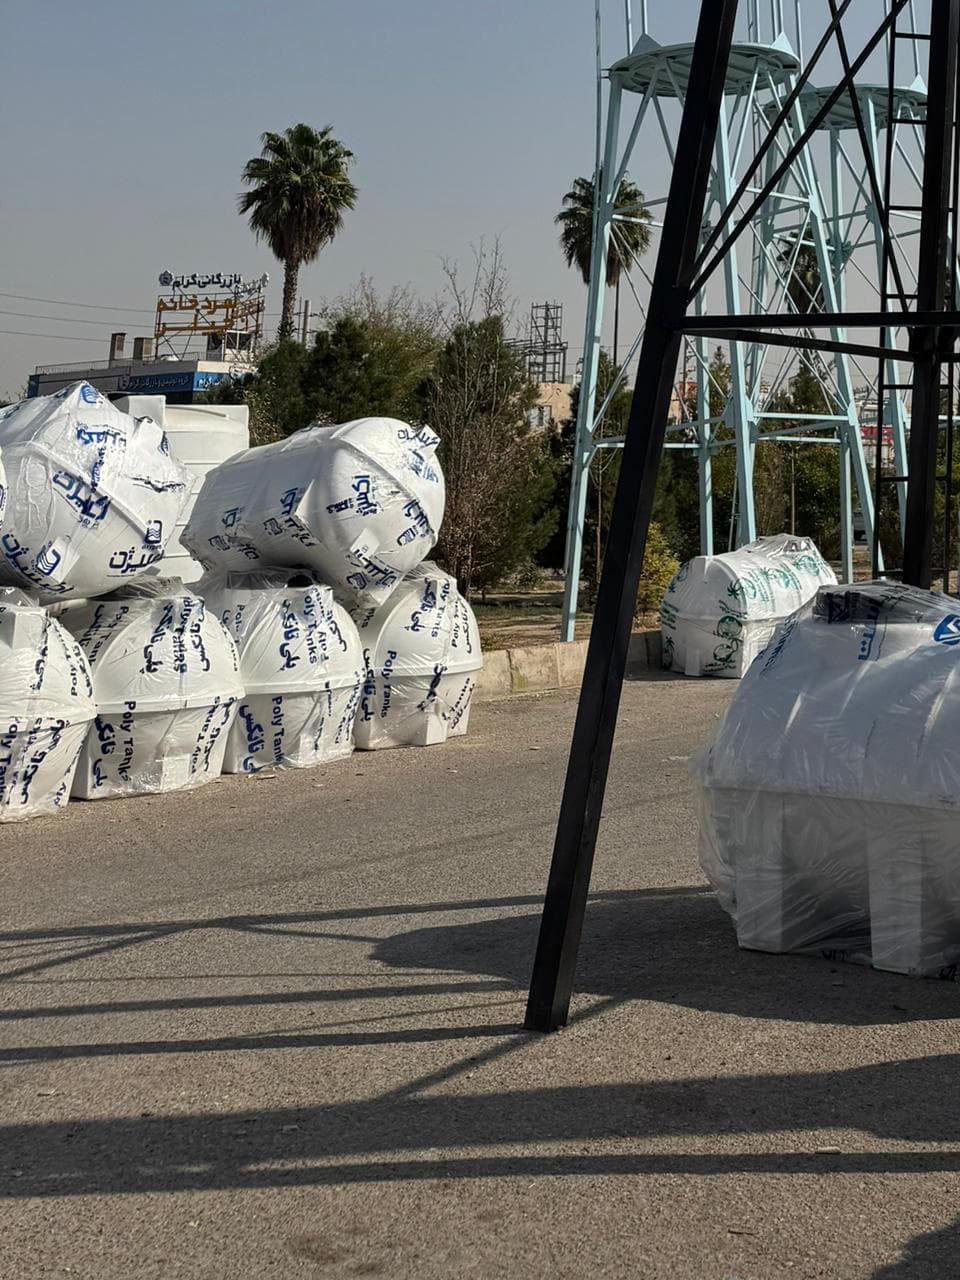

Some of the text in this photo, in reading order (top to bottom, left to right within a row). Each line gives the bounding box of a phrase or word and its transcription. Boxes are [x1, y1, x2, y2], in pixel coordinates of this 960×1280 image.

[440, 579, 451, 602] oly
[303, 595, 316, 620] oly
[138, 644, 165, 676] پلی
[279, 642, 301, 672] پلی
[381, 650, 397, 679] Poly
[271, 695, 284, 731] Poly
[117, 700, 137, 783] Poly Tanks
[238, 704, 266, 755] تانکس
